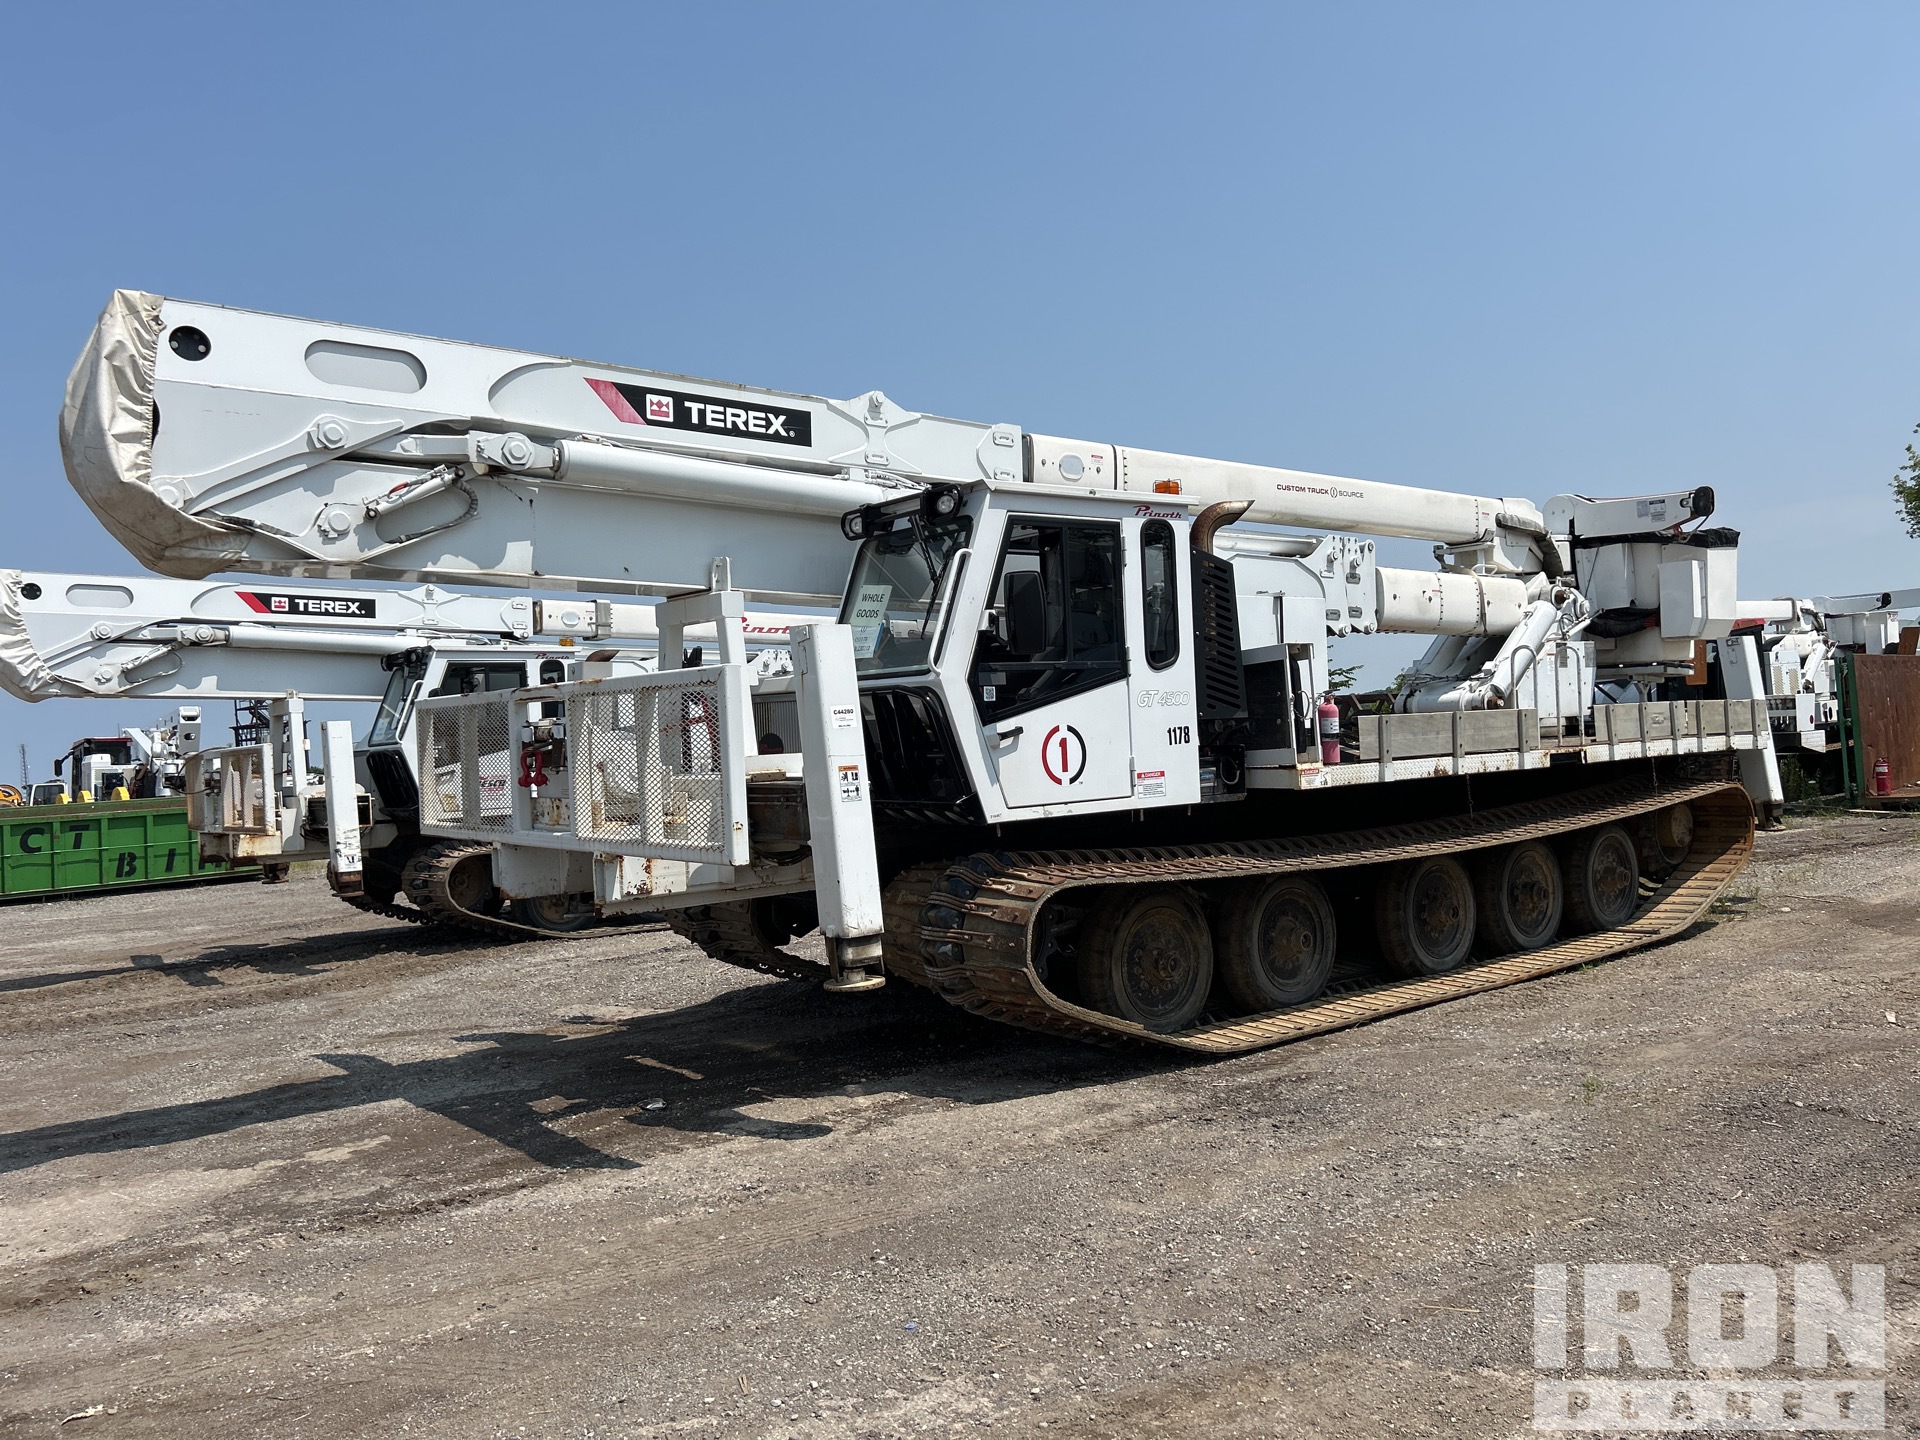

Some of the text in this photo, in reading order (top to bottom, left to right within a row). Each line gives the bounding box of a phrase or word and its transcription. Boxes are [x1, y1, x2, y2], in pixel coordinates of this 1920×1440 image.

[684, 401, 788, 436] TEREX
[1276, 484, 1306, 492] CUSTOM
[1307, 487, 1329, 495] TRUCK
[1338, 490, 1364, 498] SOURCE
[1133, 504, 1182, 518] Prinoth
[861, 593, 885, 602] WHOLE
[295, 599, 361, 614] TEREX
[856, 609, 880, 618] GOODS
[1137, 690, 1190, 707] GT 4500
[1167, 726, 1191, 746] 1178
